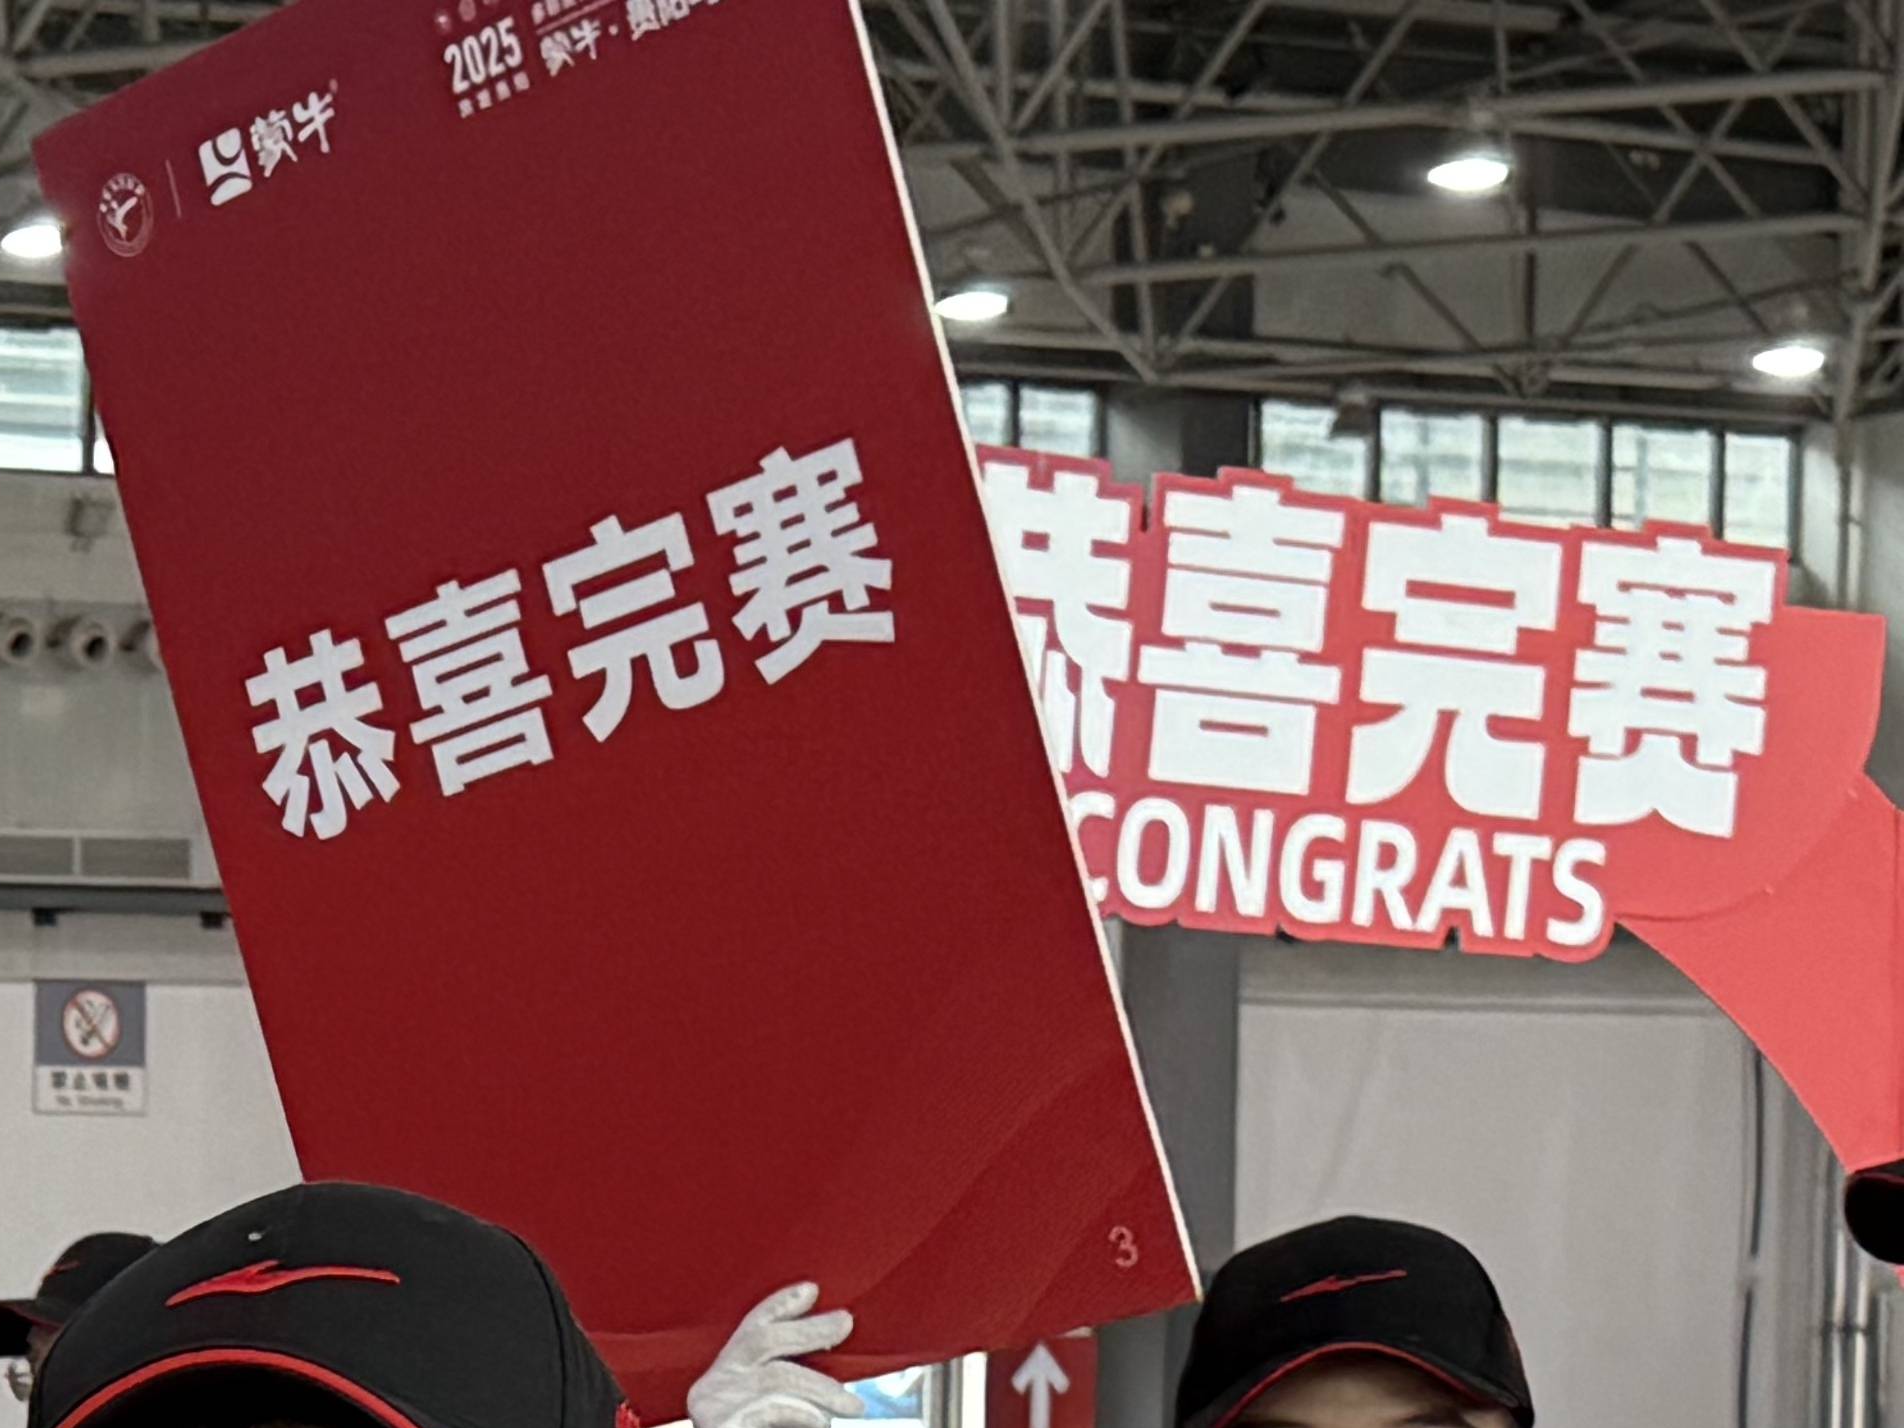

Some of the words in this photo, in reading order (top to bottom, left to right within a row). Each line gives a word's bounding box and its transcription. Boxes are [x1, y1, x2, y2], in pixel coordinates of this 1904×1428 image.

[444, 16, 523, 94] 2025
[249, 91, 335, 178] 蒙牛
[245, 438, 895, 840] 恭喜完赛
[983, 463, 1776, 837] 恭喜完赛
[1070, 790, 1607, 947] CONGRATS
[1109, 1225, 1139, 1268] 3
